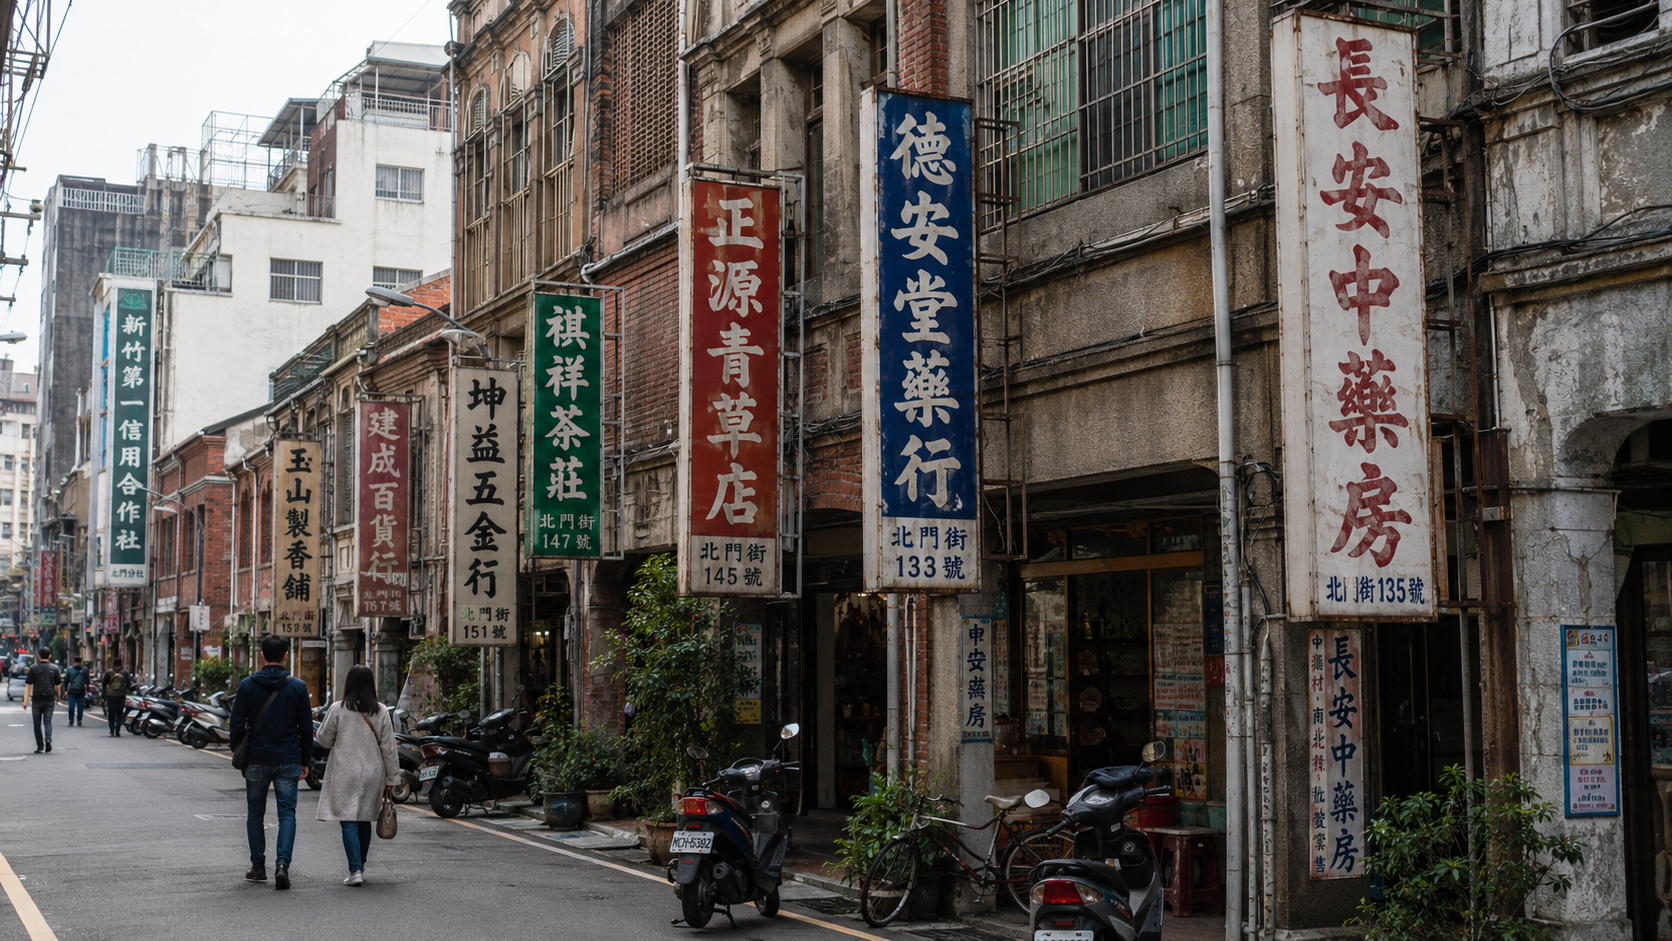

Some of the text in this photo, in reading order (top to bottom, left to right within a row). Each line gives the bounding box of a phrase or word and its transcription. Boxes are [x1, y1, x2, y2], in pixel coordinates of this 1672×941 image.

[705, 197, 765, 526] 正源青草店
[889, 110, 962, 510] 德安堂藥行
[1317, 36, 1413, 569] 長安中藥房
[115, 314, 147, 551] 新竹第一信用合作社
[545, 304, 590, 501] 祺祥茶莊
[281, 447, 313, 603] 玉山製香舖
[367, 407, 401, 583] 建成百貨行
[464, 380, 507, 598] 坤益五金行
[539, 514, 595, 531] 北門街
[542, 533, 592, 551] 147號
[699, 542, 767, 563] 北門街
[891, 526, 968, 551] 北門街
[460, 607, 510, 622] 北門街
[463, 625, 507, 639] 151號
[704, 566, 762, 588] 145號
[896, 554, 967, 581] 133號
[1328, 635, 1359, 874] 長安中藥房
